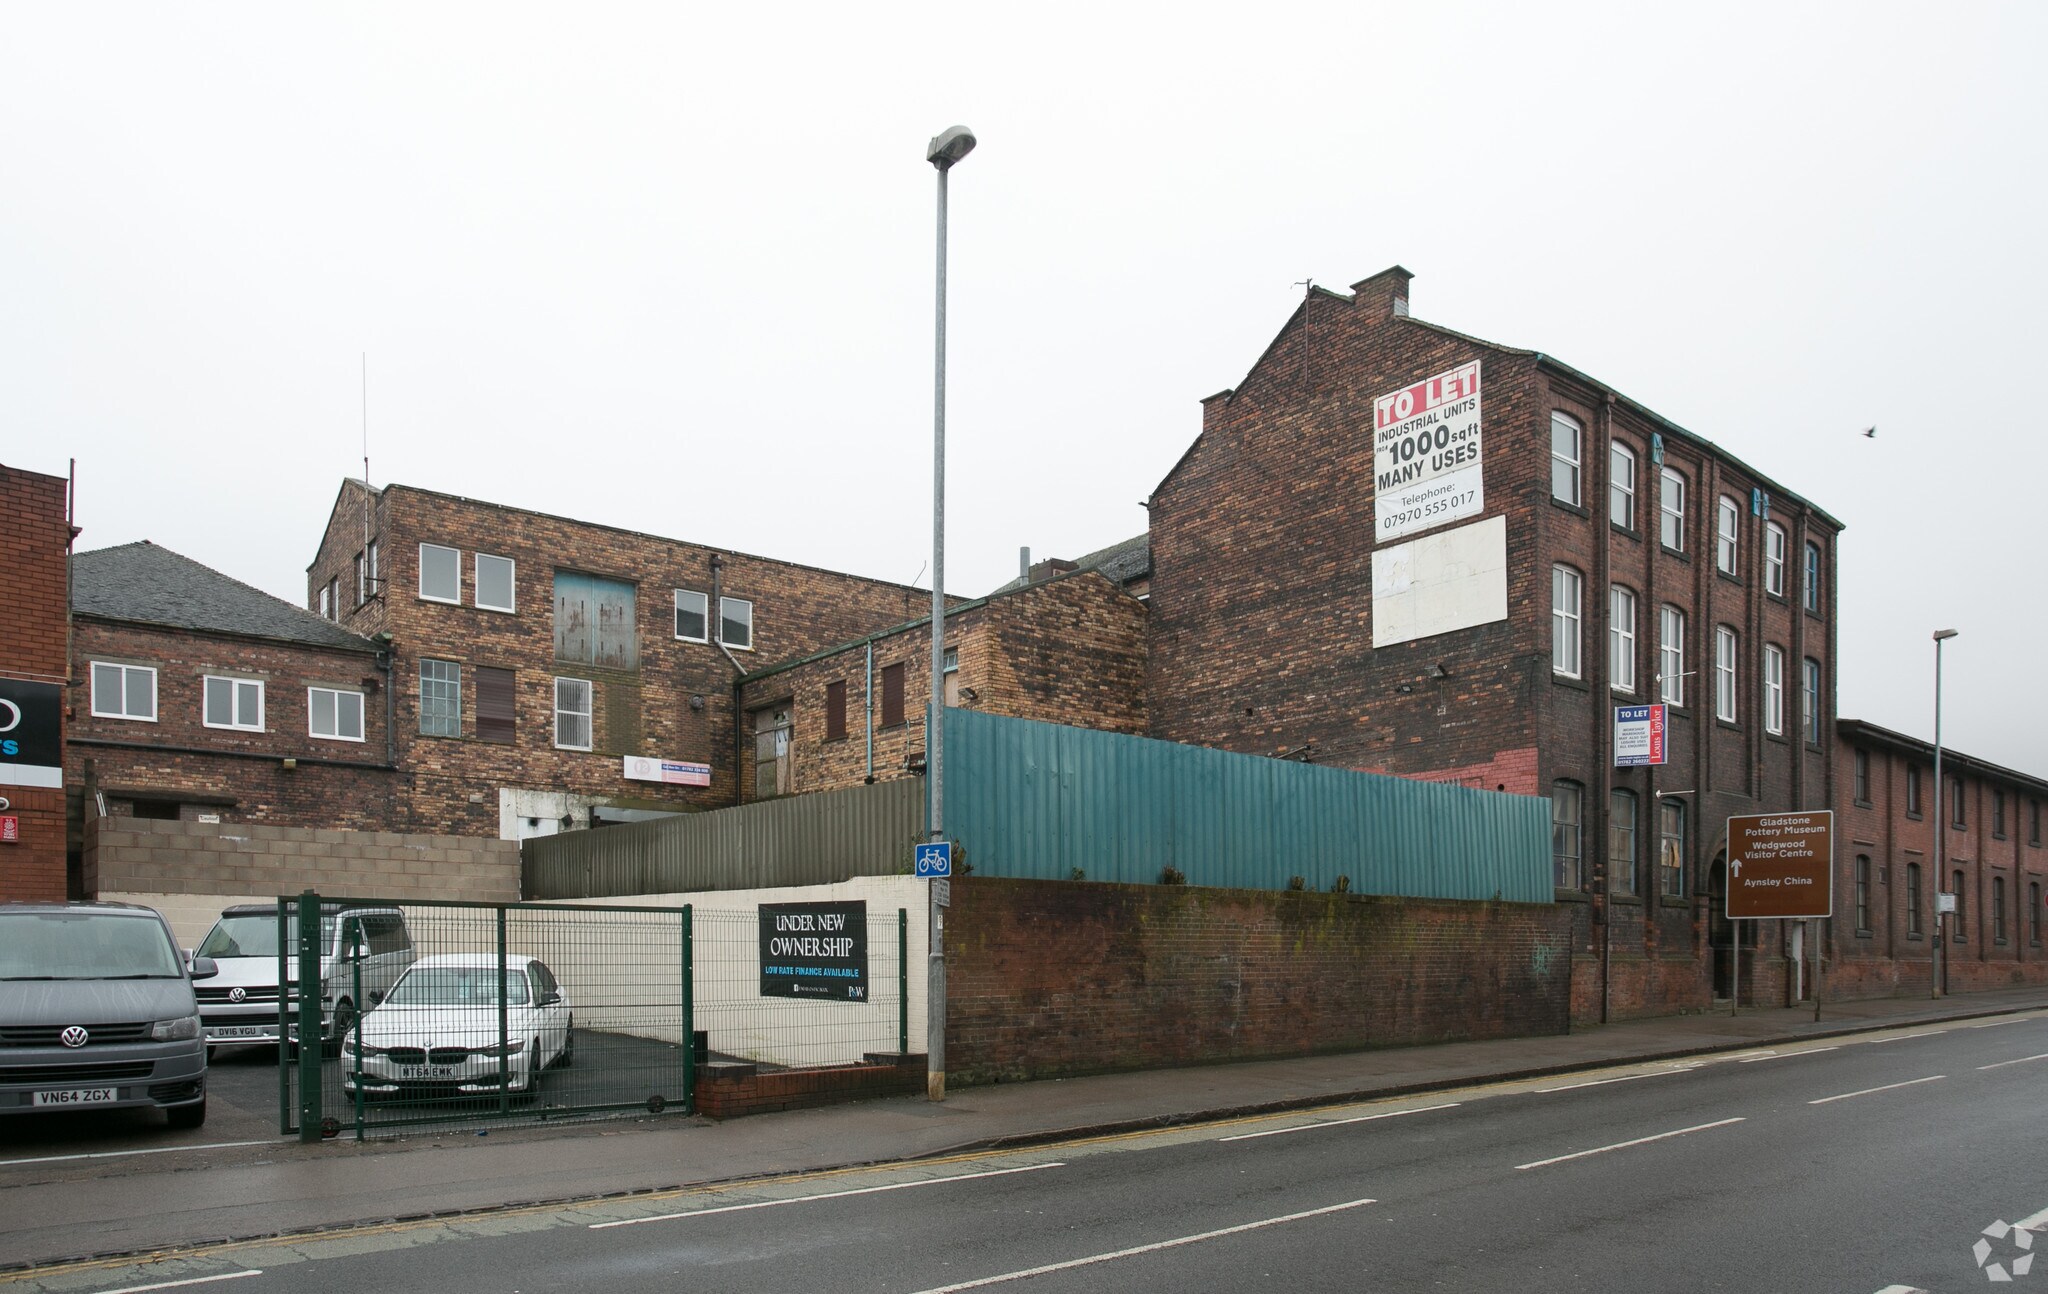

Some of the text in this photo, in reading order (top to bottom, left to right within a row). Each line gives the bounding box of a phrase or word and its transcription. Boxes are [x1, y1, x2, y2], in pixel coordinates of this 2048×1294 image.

[1379, 366, 1476, 425] TO LET
[1378, 398, 1476, 443] INDUSTRIAL UNITS
[1378, 442, 1477, 491] MANY USES
[1402, 483, 1455, 507] Telephone:
[1384, 490, 1474, 528] 07970 555 017
[1652, 710, 1664, 759] Louis Taylor
[1760, 818, 1810, 826] Gladstone
[1746, 826, 1825, 836] Pottery Museum
[1752, 840, 1805, 850] Wedgwood
[1780, 850, 1813, 858] Centre
[1745, 877, 1812, 888] Aynsley China
[776, 914, 845, 931] UNDER NEW
[770, 937, 853, 957] OWNERSHIP
[765, 966, 859, 978] LOW RATE FINANCE AVAILABLE
[41, 1089, 111, 1103] VN64 ZGX
